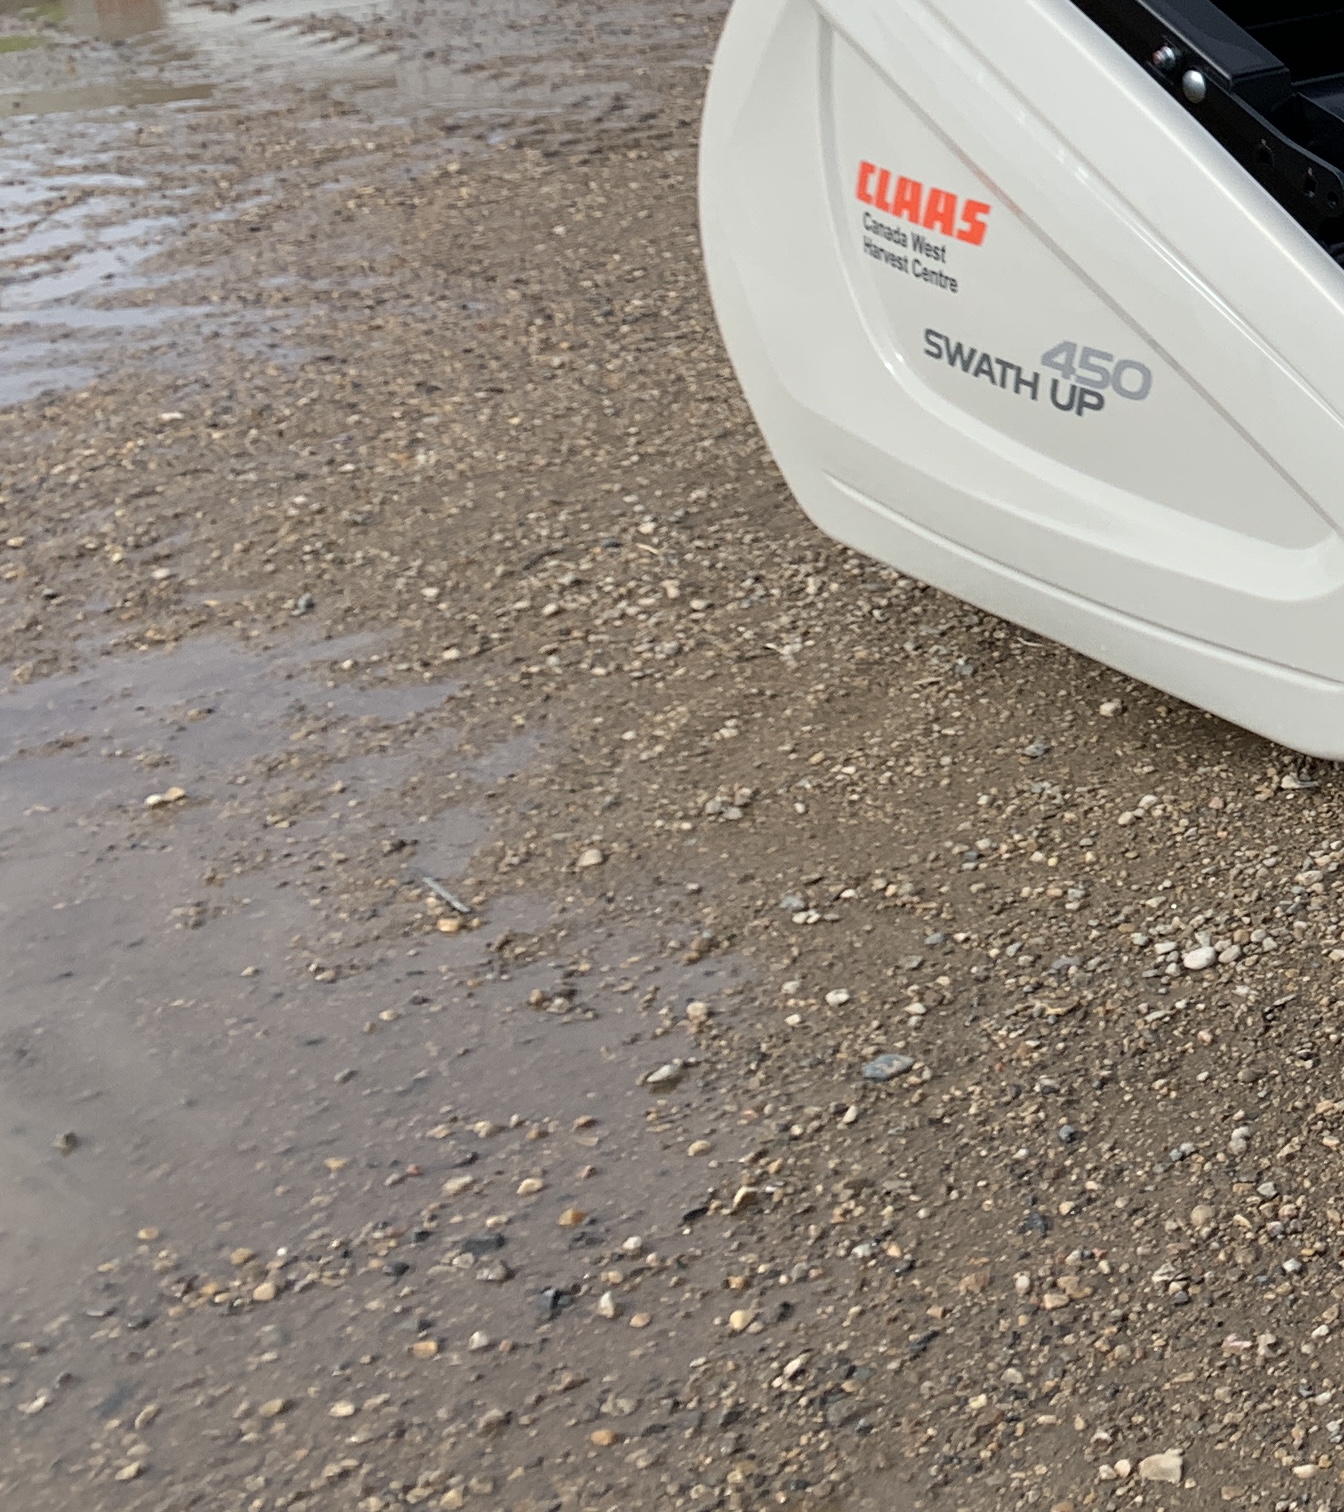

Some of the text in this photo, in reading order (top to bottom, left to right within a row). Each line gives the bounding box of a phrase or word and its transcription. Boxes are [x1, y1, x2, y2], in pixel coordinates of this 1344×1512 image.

[856, 160, 991, 246] CLAAS
[863, 211, 946, 264] Canada West
[863, 235, 959, 293] Harvest Centre
[923, 328, 1105, 416] SWATH UP
[1041, 341, 1153, 400] 450
